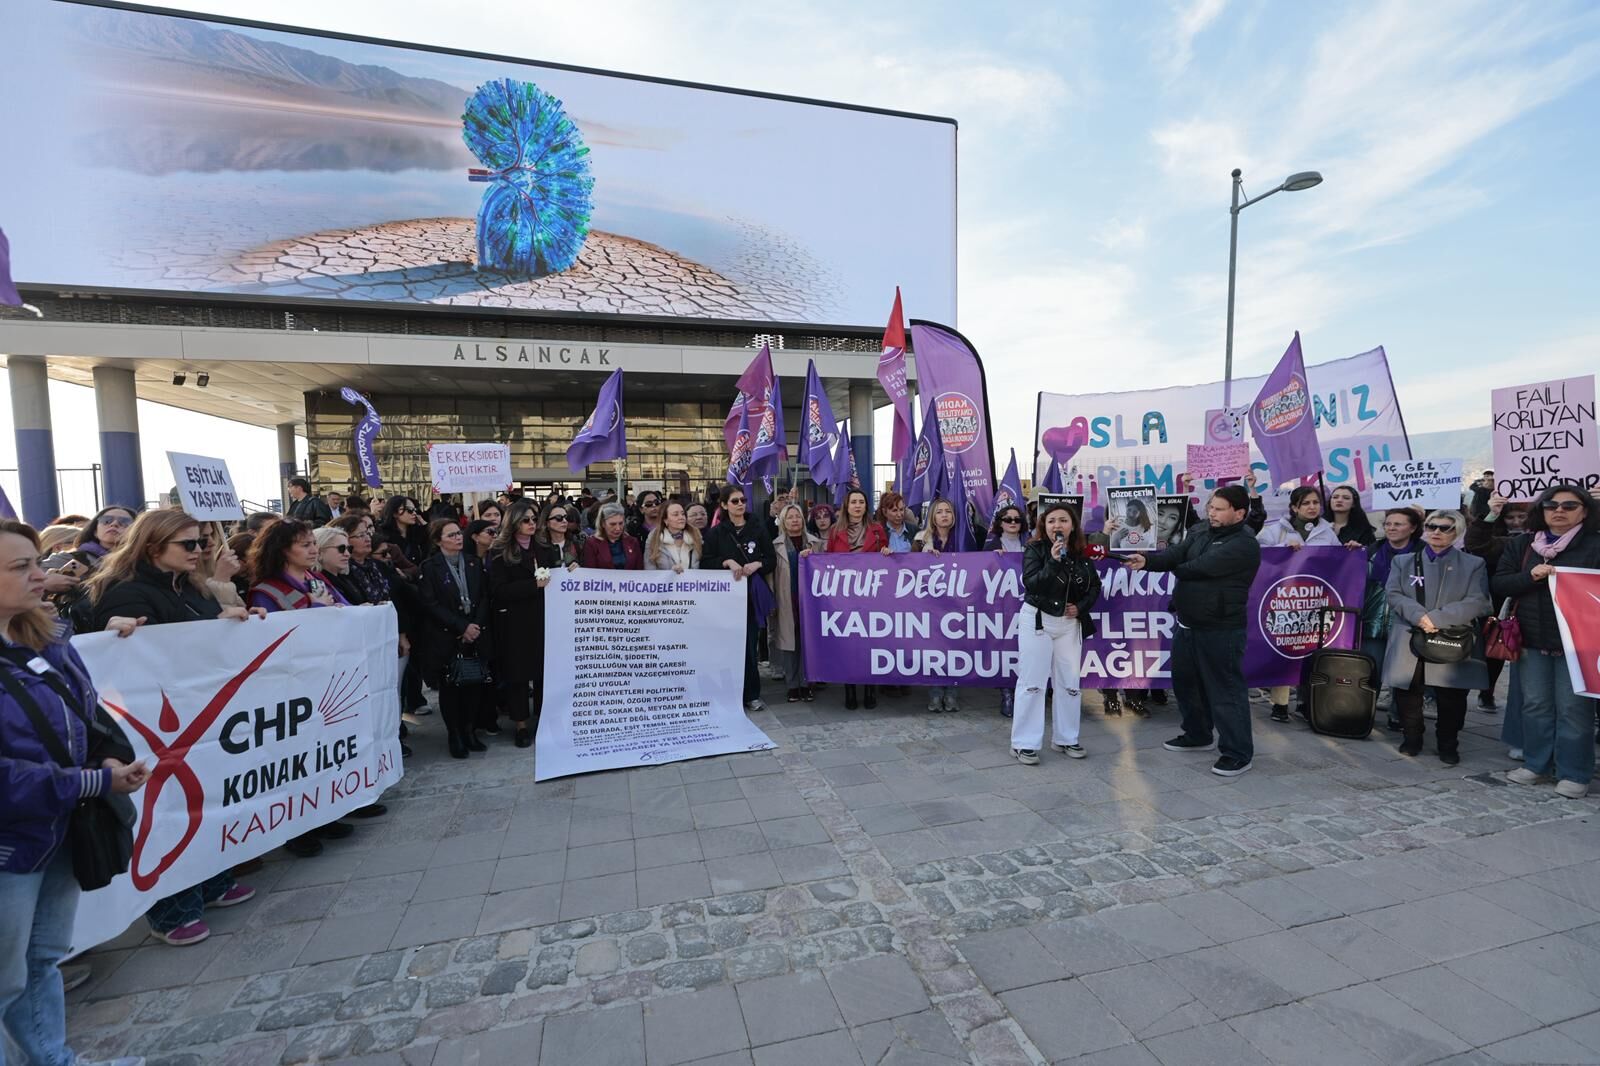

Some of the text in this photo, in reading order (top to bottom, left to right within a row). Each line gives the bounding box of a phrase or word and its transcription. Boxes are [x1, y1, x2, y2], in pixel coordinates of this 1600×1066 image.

[453, 343, 611, 366] ALSANCAK
[1494, 401, 1596, 431] KORUYAN
[1066, 411, 1168, 449] ASLA
[1510, 428, 1584, 452] DÜZEN
[358, 422, 374, 477] NEREDE
[437, 451, 476, 464] ERKEK
[1520, 454, 1560, 475] SUÇ
[1379, 462, 1436, 473] AÇ GEL
[185, 464, 227, 488] EŞİTLİK
[1393, 471, 1439, 482] YEMEKTE
[1110, 488, 1153, 499] GÖZDE ÇETİN
[1388, 488, 1424, 502] VAR
[189, 490, 237, 512] YAŞATIR!
[561, 579, 731, 594] SÖZ BİZİM, MÜCADELE HEPİMİZİN!
[811, 565, 888, 598] LÜTUF
[895, 563, 973, 599] DEĞİL
[1277, 586, 1324, 598] KADIN
[599, 599, 632, 607] DİRENİŞİ
[575, 617, 626, 625] SUSMUYORUZ,
[820, 611, 931, 638] KADIN
[575, 635, 591, 643] EŞİT
[607, 635, 624, 643] EŞİT
[1427, 639, 1462, 648] BALENCIAGA
[574, 643, 610, 652] İSTANBUL
[645, 661, 658, 669] BİR
[871, 642, 1172, 679] DURDURAĞIZ
[574, 671, 633, 680] HAKLARIMIZDAN
[598, 680, 631, 688] UYGULA!
[573, 691, 596, 699] KADIN
[600, 698, 625, 706] KADIN,
[572, 710, 593, 718] GECE
[608, 707, 633, 715] SOKAK
[648, 704, 677, 712] MEYDAN
[219, 696, 313, 755] CHP
[599, 717, 628, 725] ADALET
[629, 714, 651, 723] DEĞİL
[652, 712, 680, 720] GERÇEK
[222, 735, 358, 808] KONAK İLÇE
[221, 786, 319, 852] KADIN
